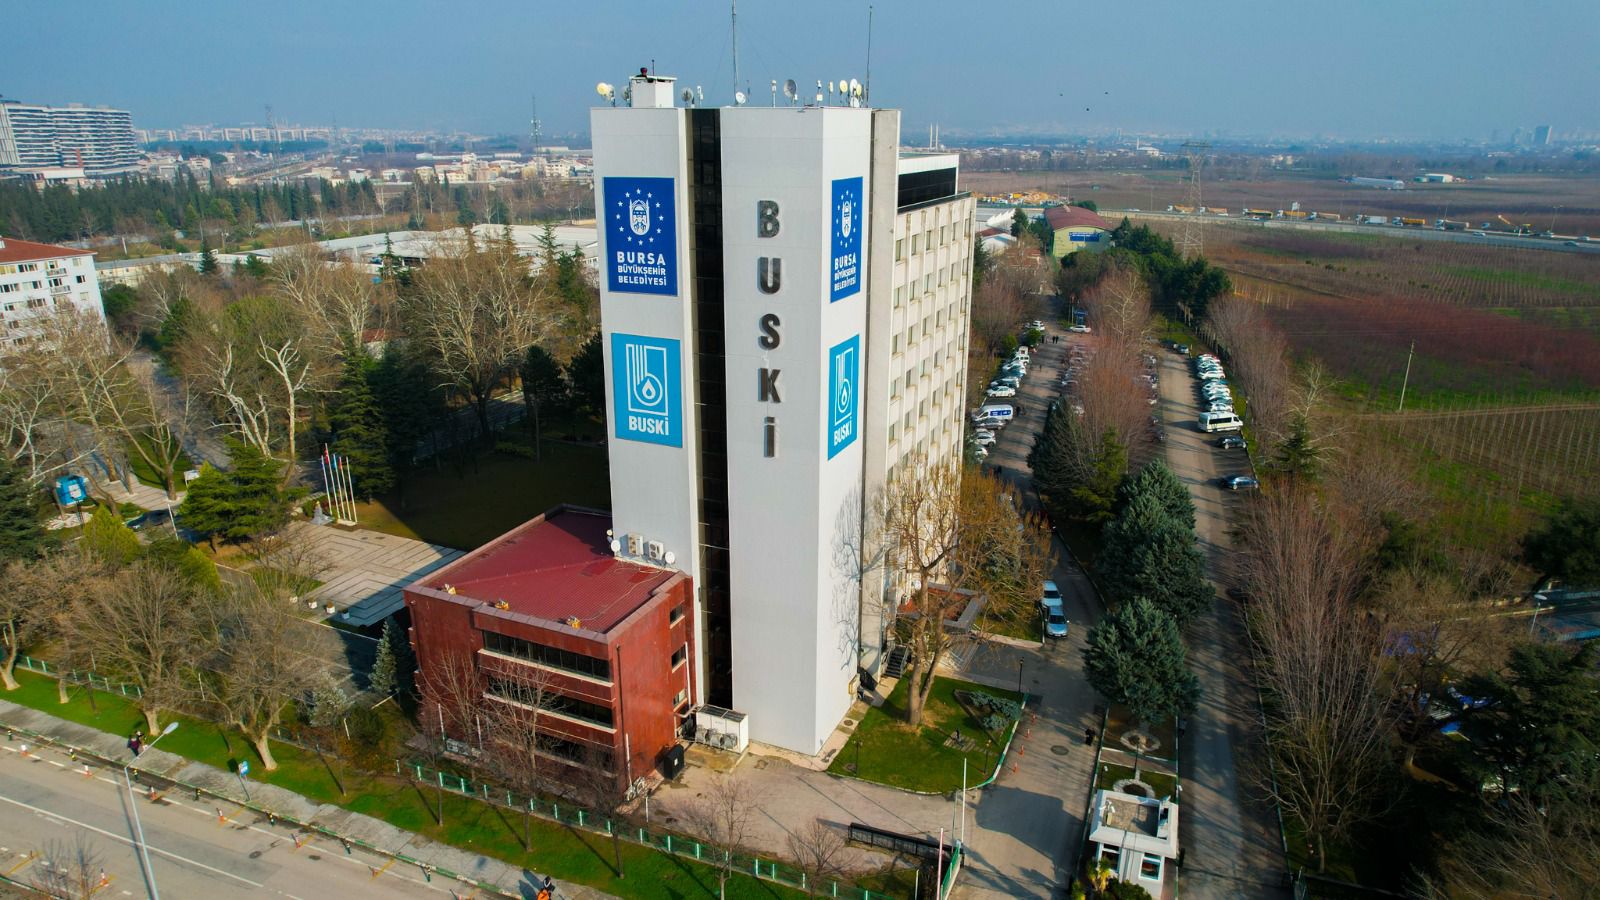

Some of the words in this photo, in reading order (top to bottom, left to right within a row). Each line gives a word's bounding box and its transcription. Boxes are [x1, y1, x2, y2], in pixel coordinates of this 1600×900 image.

[617, 250, 666, 266] BURSA
[834, 252, 857, 271] BURSA
[617, 263, 666, 276] BÜYÜKŞEHİR
[618, 274, 667, 286] BELEDİYESİ
[756, 200, 782, 458] BUSKİ
[628, 415, 669, 436] BUSKİ
[833, 416, 852, 446] BUSKİ
